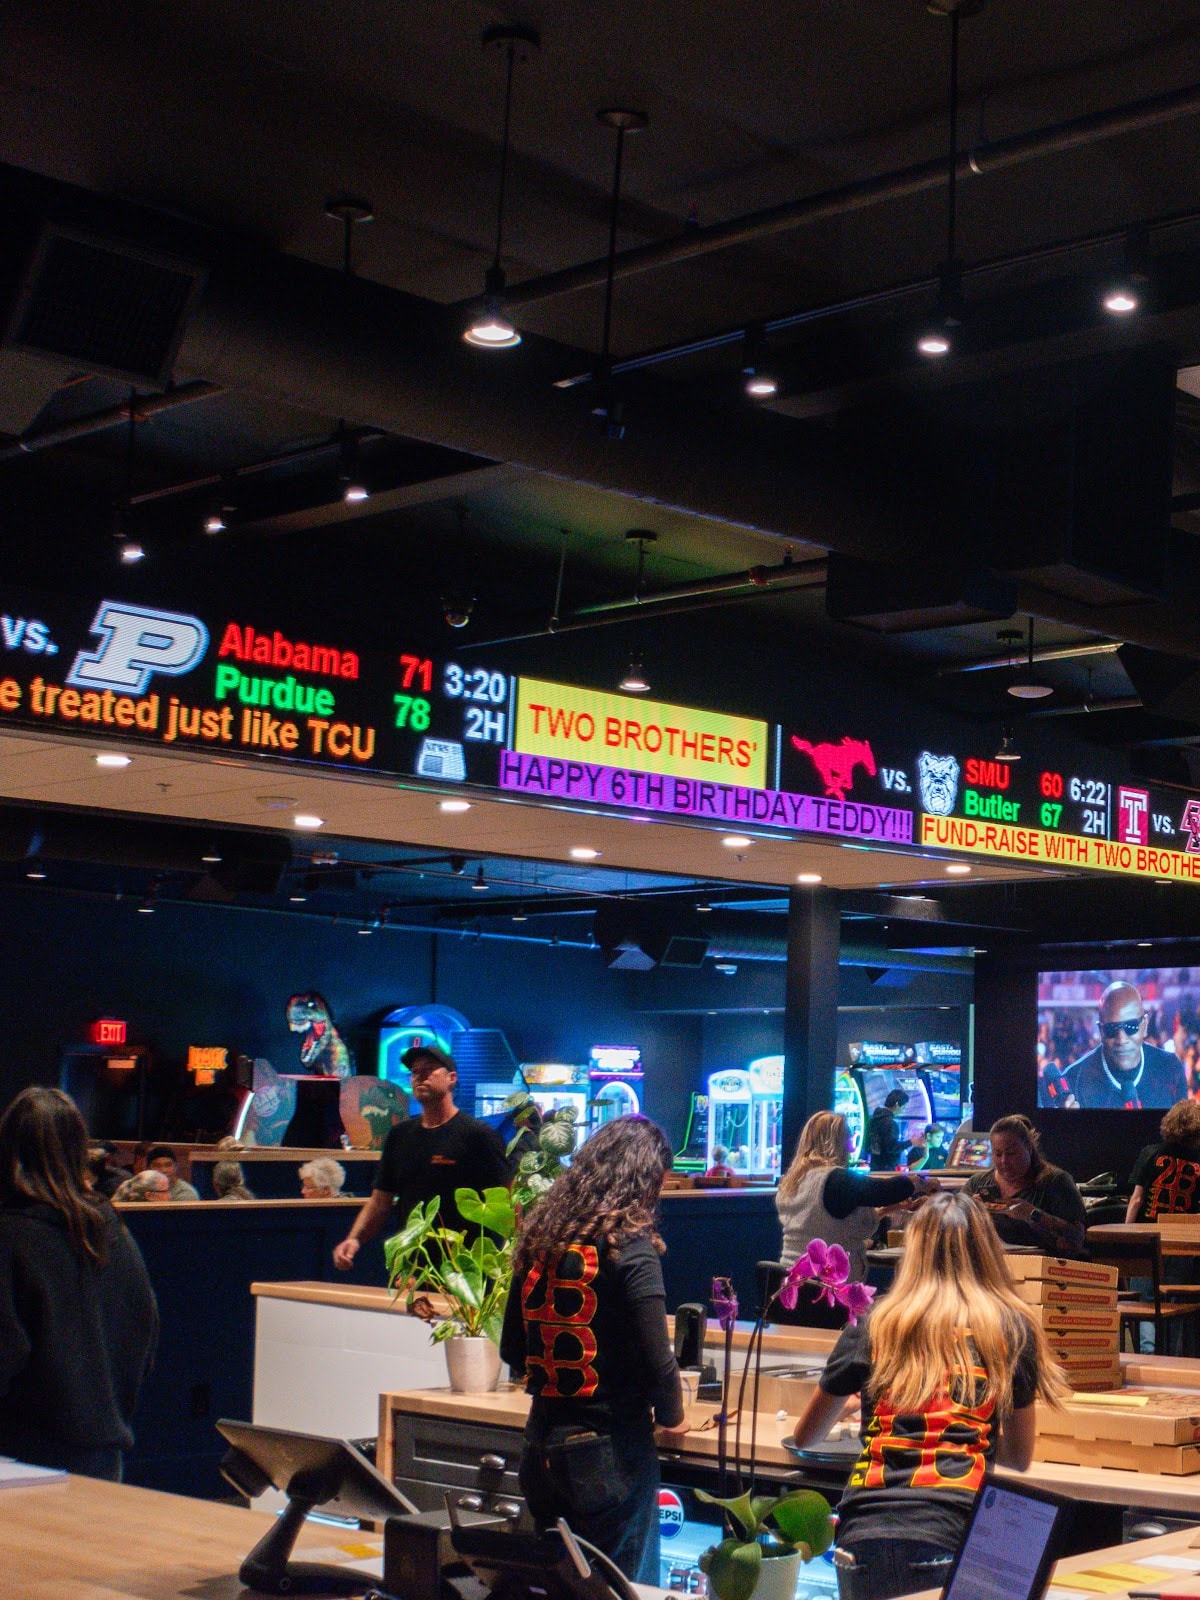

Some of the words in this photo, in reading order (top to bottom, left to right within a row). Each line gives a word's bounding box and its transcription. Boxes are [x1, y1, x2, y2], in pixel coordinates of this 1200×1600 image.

[1, 615, 58, 654] vs.
[218, 622, 360, 679] Alabama
[215, 664, 335, 716] Purdue
[399, 655, 433, 692] 71
[444, 663, 507, 704] 3:20
[30, 677, 159, 729] treated
[164, 697, 233, 742] just
[242, 709, 299, 749] like
[307, 718, 375, 759] TCU
[393, 694, 431, 731] 78
[465, 707, 505, 742] 2H
[528, 704, 595, 742] TWO
[880, 767, 912, 793] vs.
[965, 759, 1010, 789] SMU
[1040, 772, 1063, 797] 60
[504, 756, 602, 797] HAPPY
[612, 770, 663, 807] 6TH
[674, 778, 801, 825] BIRTHDAY
[811, 799, 912, 840] TEDDY!!!
[964, 789, 1020, 823] Butler
[1070, 778, 1105, 806] 6:22
[1040, 804, 1063, 828] 67
[1083, 809, 1106, 835] 2H
[1152, 814, 1175, 835] vs.
[923, 816, 1039, 857] FUND-RAISE
[1044, 834, 1088, 862] WITH
[1094, 842, 1131, 869] TWO
[101, 1023, 122, 1041] EXIT
[659, 1508, 681, 1521] EPSI
